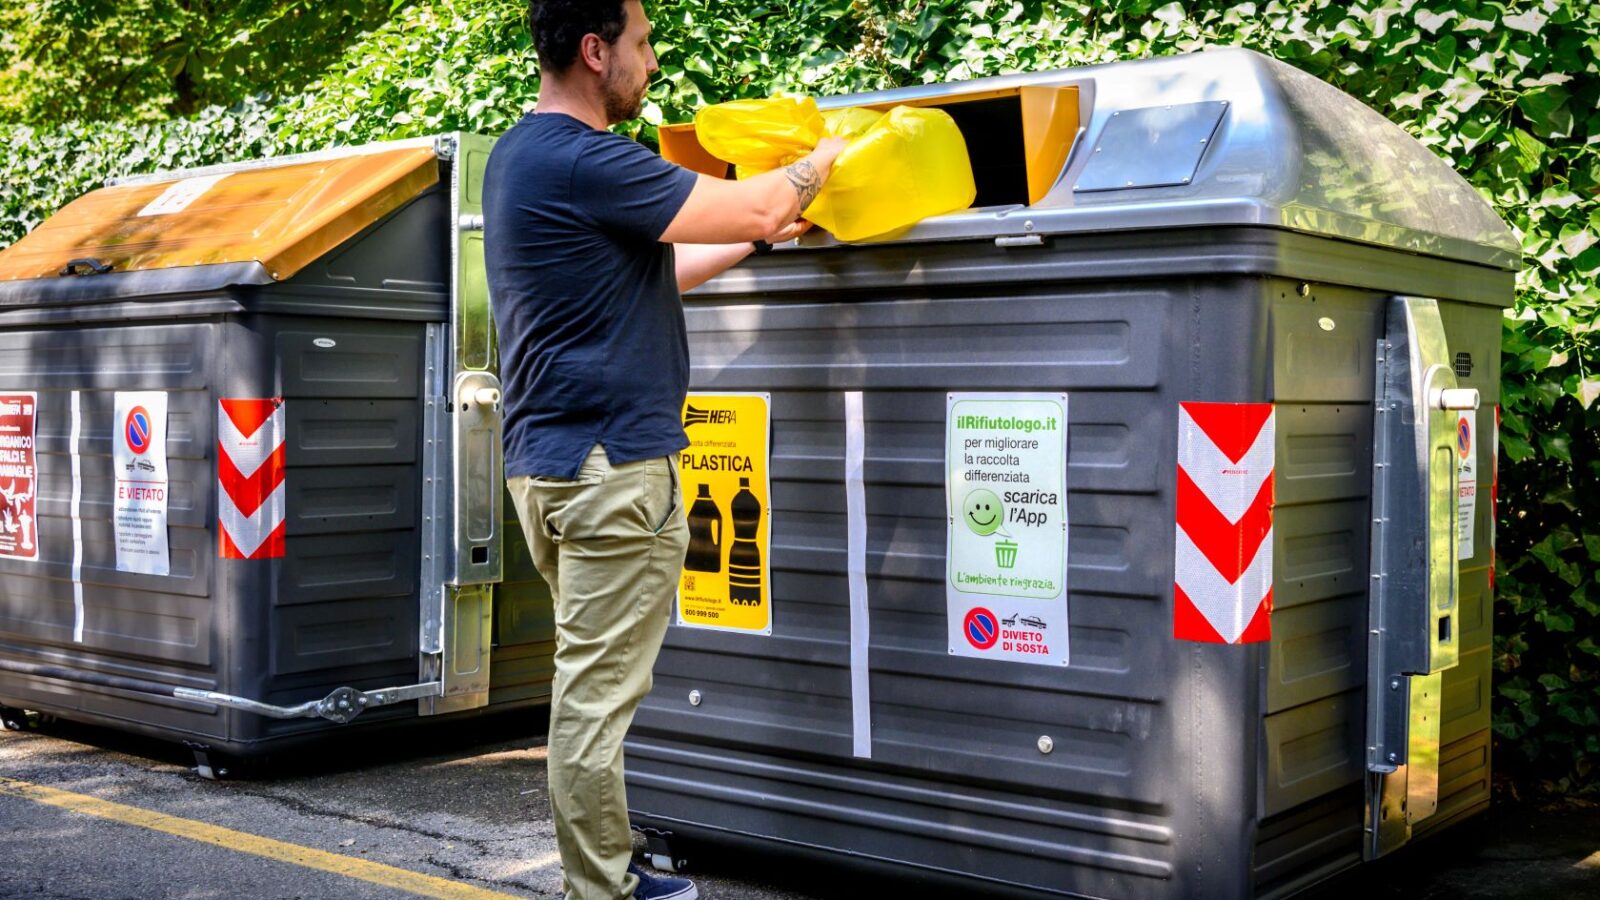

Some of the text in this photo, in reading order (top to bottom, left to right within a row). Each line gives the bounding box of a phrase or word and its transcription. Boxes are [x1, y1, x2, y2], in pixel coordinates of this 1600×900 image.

[709, 410, 736, 424] HERA
[957, 416, 1056, 432] ilRifiutologo.it
[964, 437, 1039, 451] per migliorare
[682, 454, 753, 472] PLASTICA
[964, 453, 1020, 466] la raccolta
[964, 469, 1030, 483] differenziata
[127, 488, 163, 501] VIETATO
[1003, 489, 1057, 505] scarica
[1010, 578, 1056, 590] ringrazia.
[1002, 630, 1043, 642] DIVIETO
[1003, 642, 1049, 655] DI SOSTA
